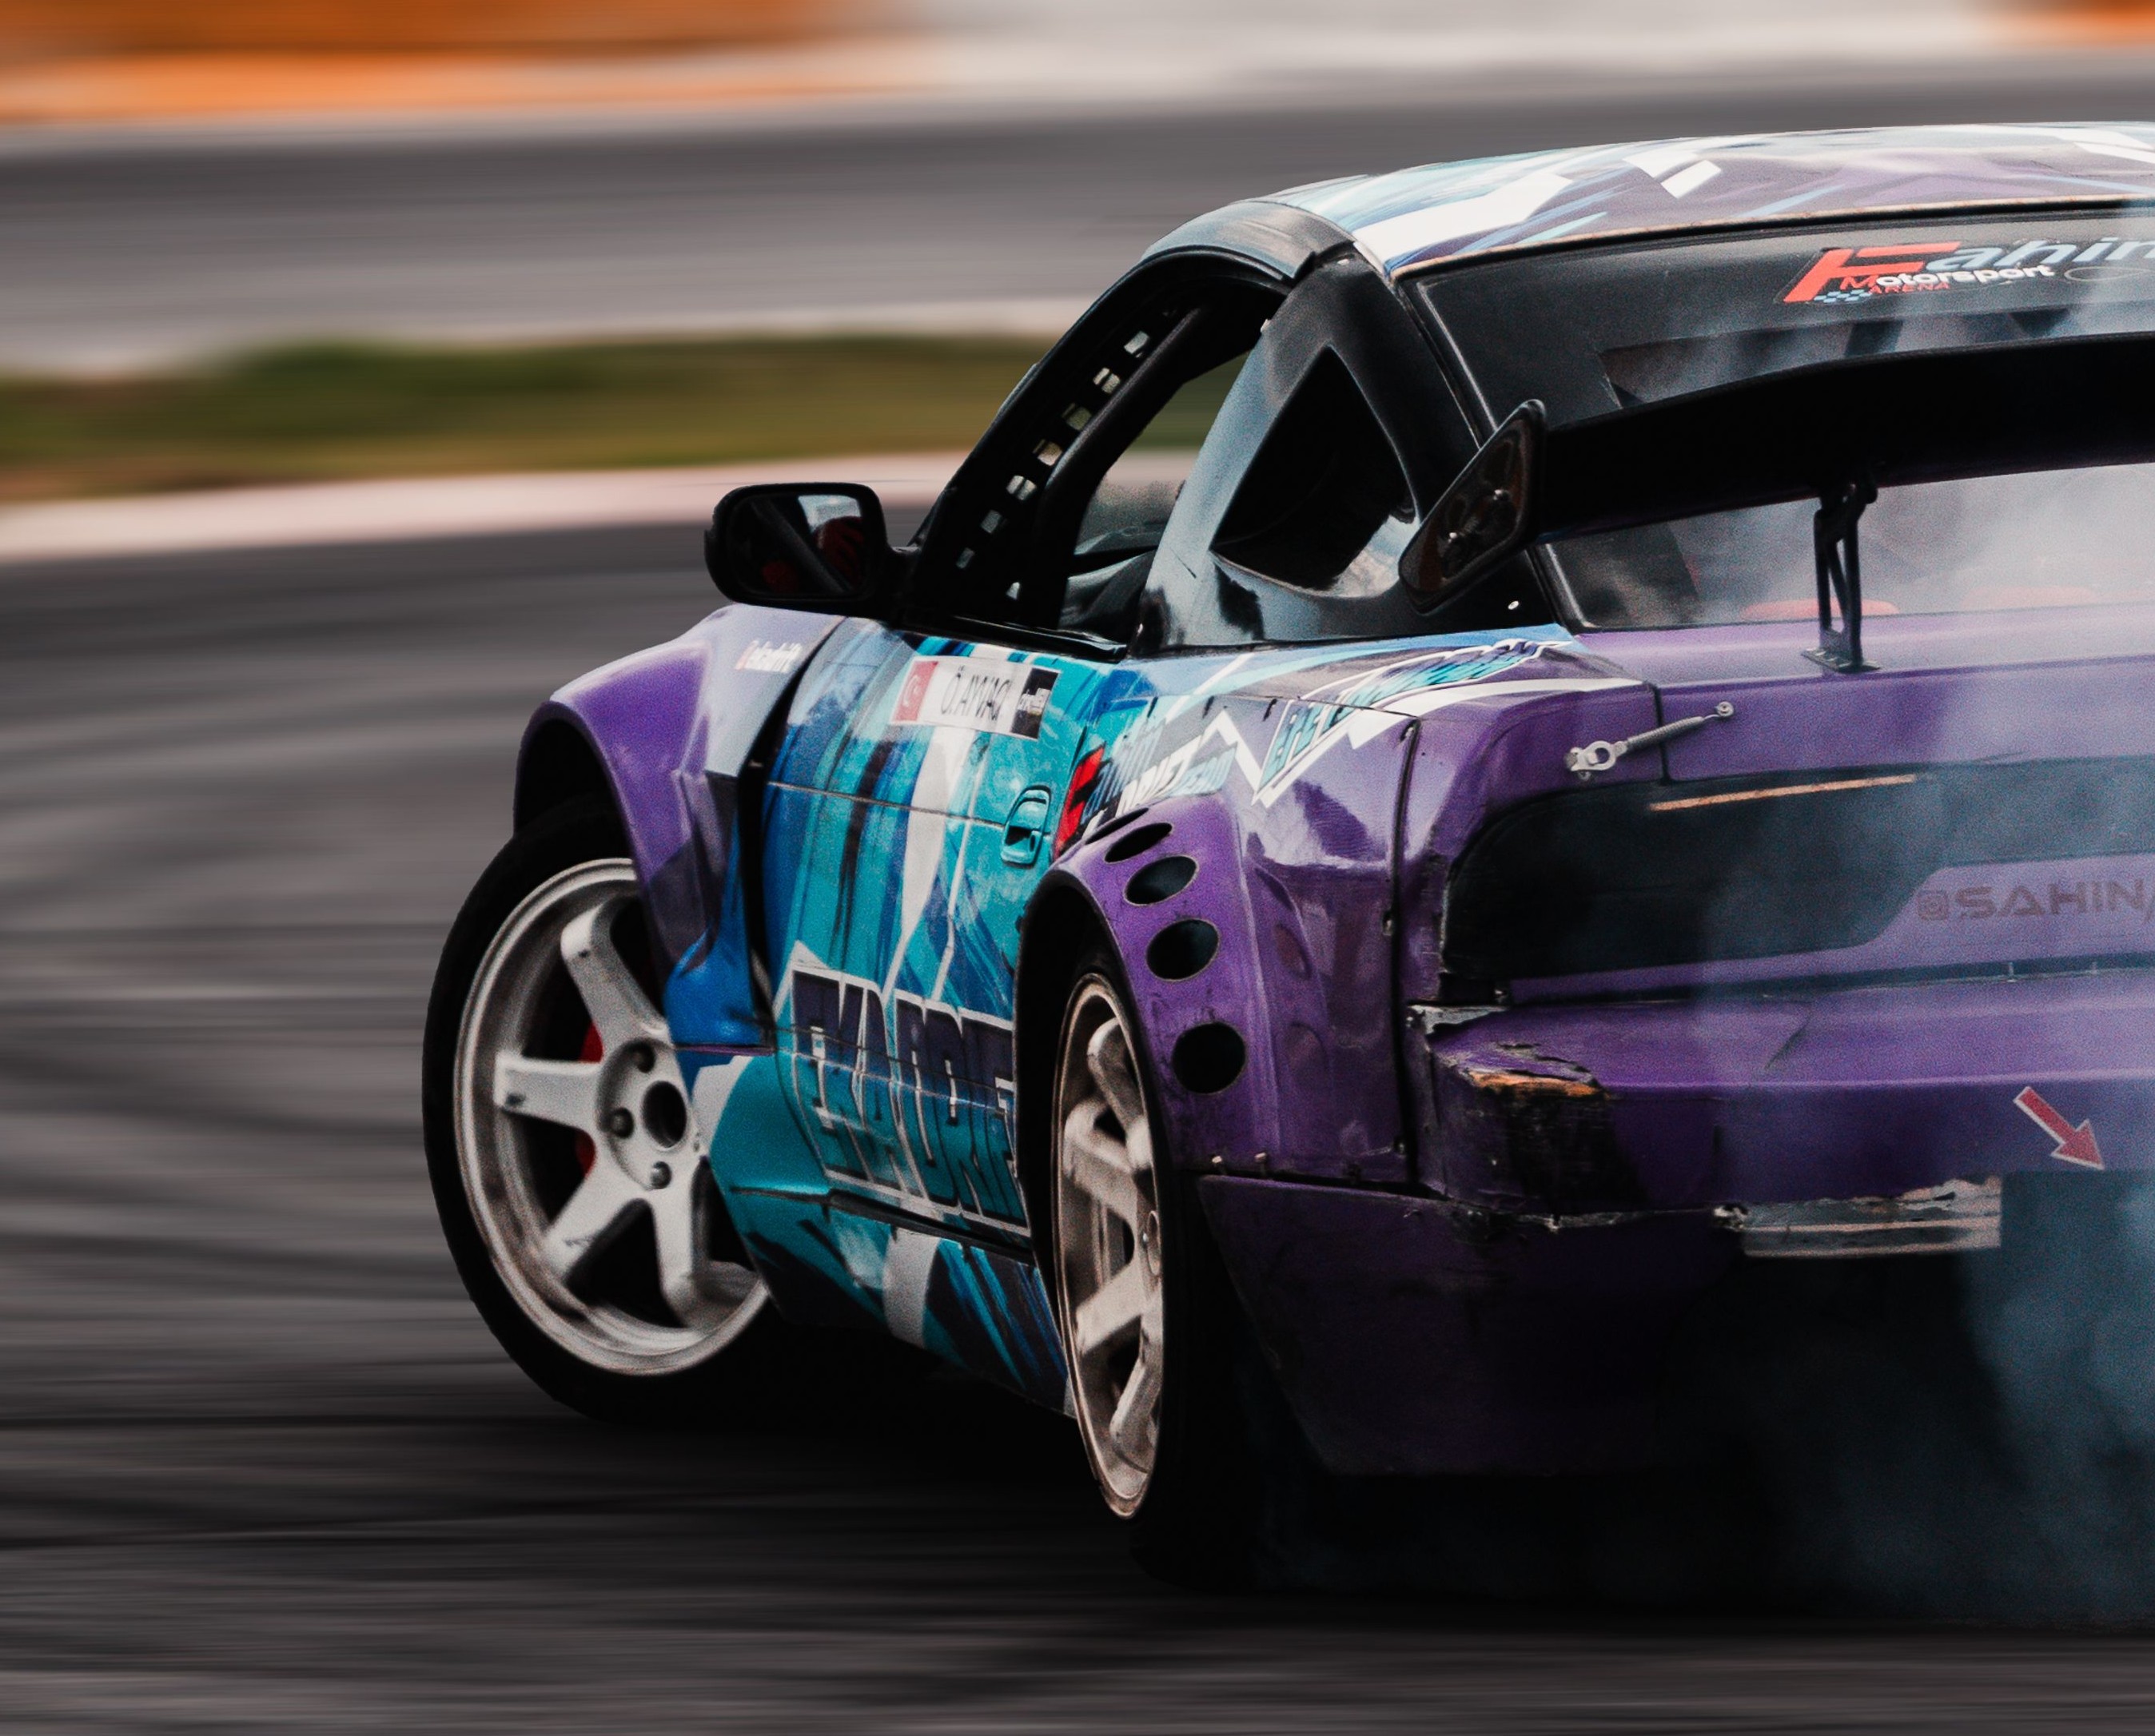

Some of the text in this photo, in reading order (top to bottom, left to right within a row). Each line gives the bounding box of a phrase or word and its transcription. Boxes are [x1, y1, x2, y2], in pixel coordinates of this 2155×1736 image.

[1840, 264, 2055, 291] Motorsport
[1868, 281, 1950, 294] ARENA
[1955, 878, 2155, 922] SAHIN
